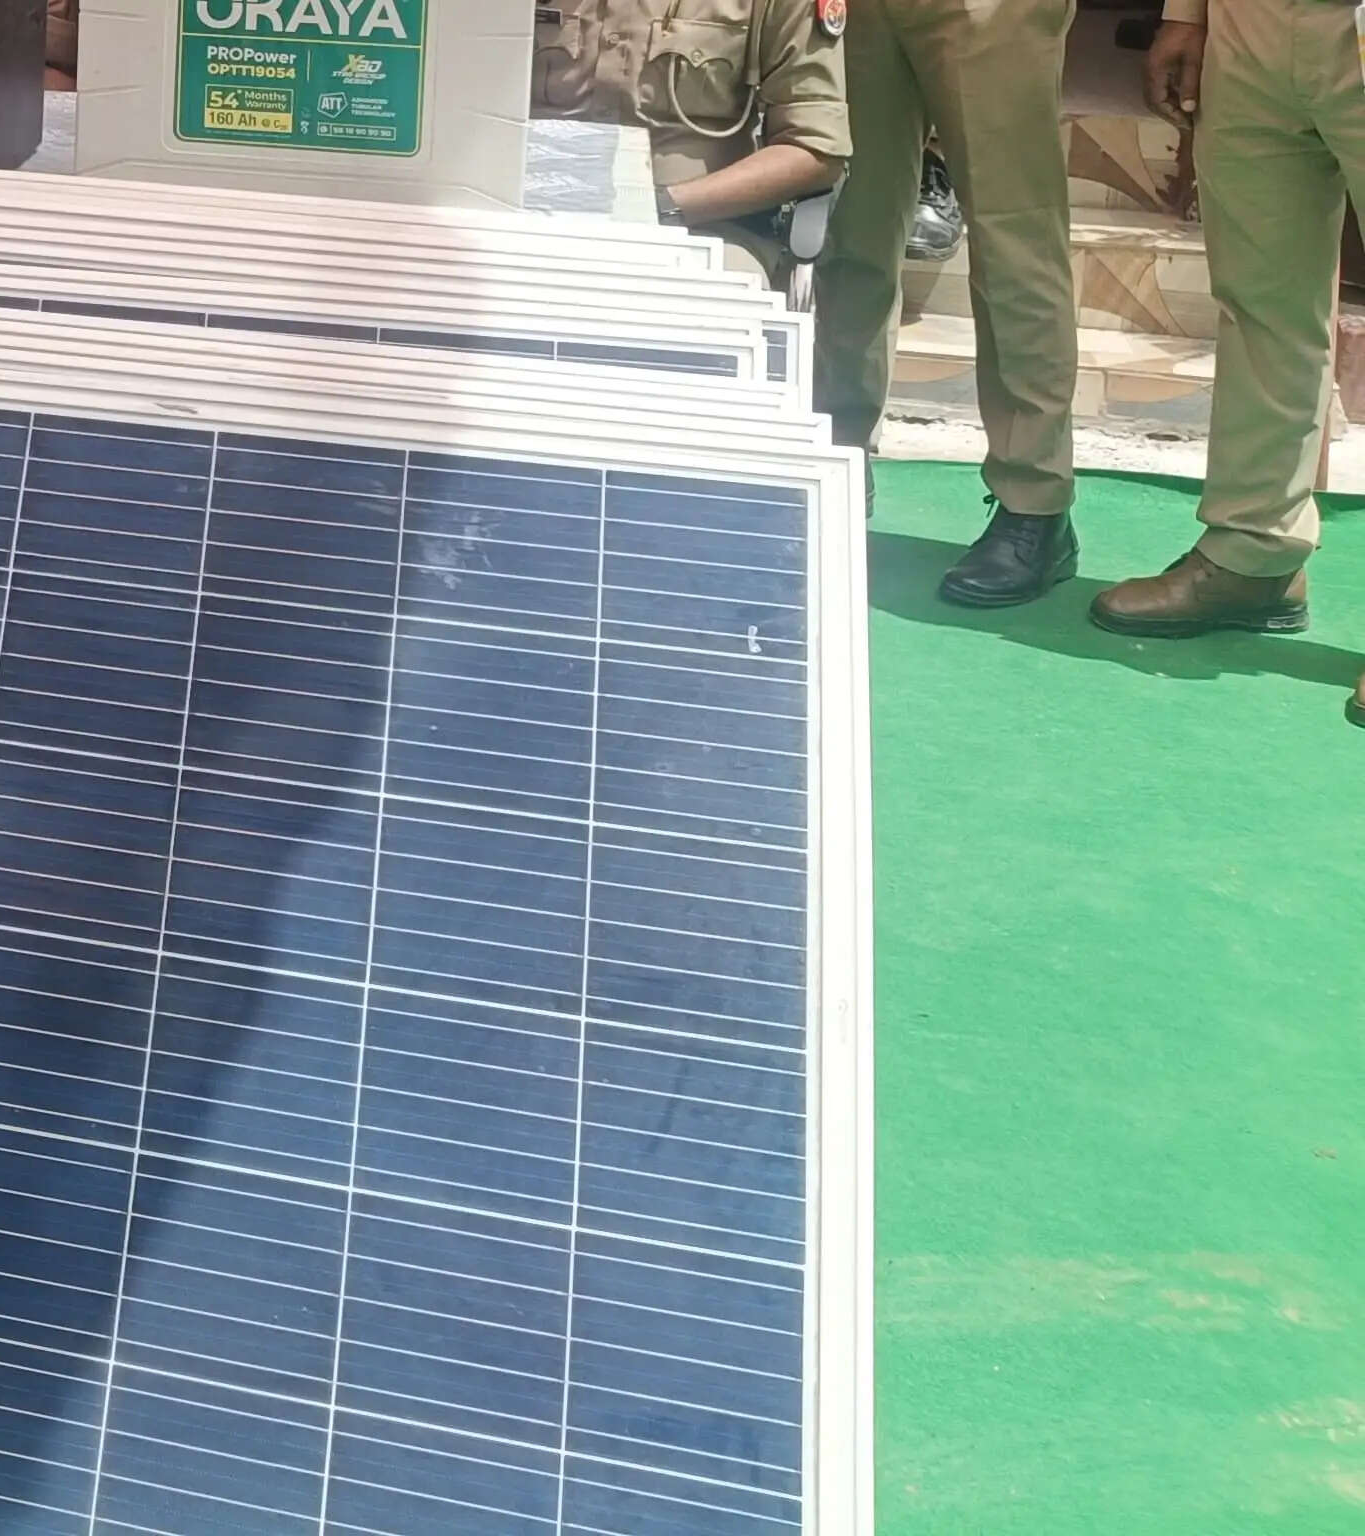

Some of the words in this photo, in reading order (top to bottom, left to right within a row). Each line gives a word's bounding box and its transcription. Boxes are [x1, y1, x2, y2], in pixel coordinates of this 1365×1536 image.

[207, 45, 297, 65] PROPower
[244, 90, 287, 103] Months
[320, 96, 343, 110] ATT
[245, 100, 287, 112] Warranty
[208, 111, 235, 126] 160
[237, 112, 257, 128] Ah
